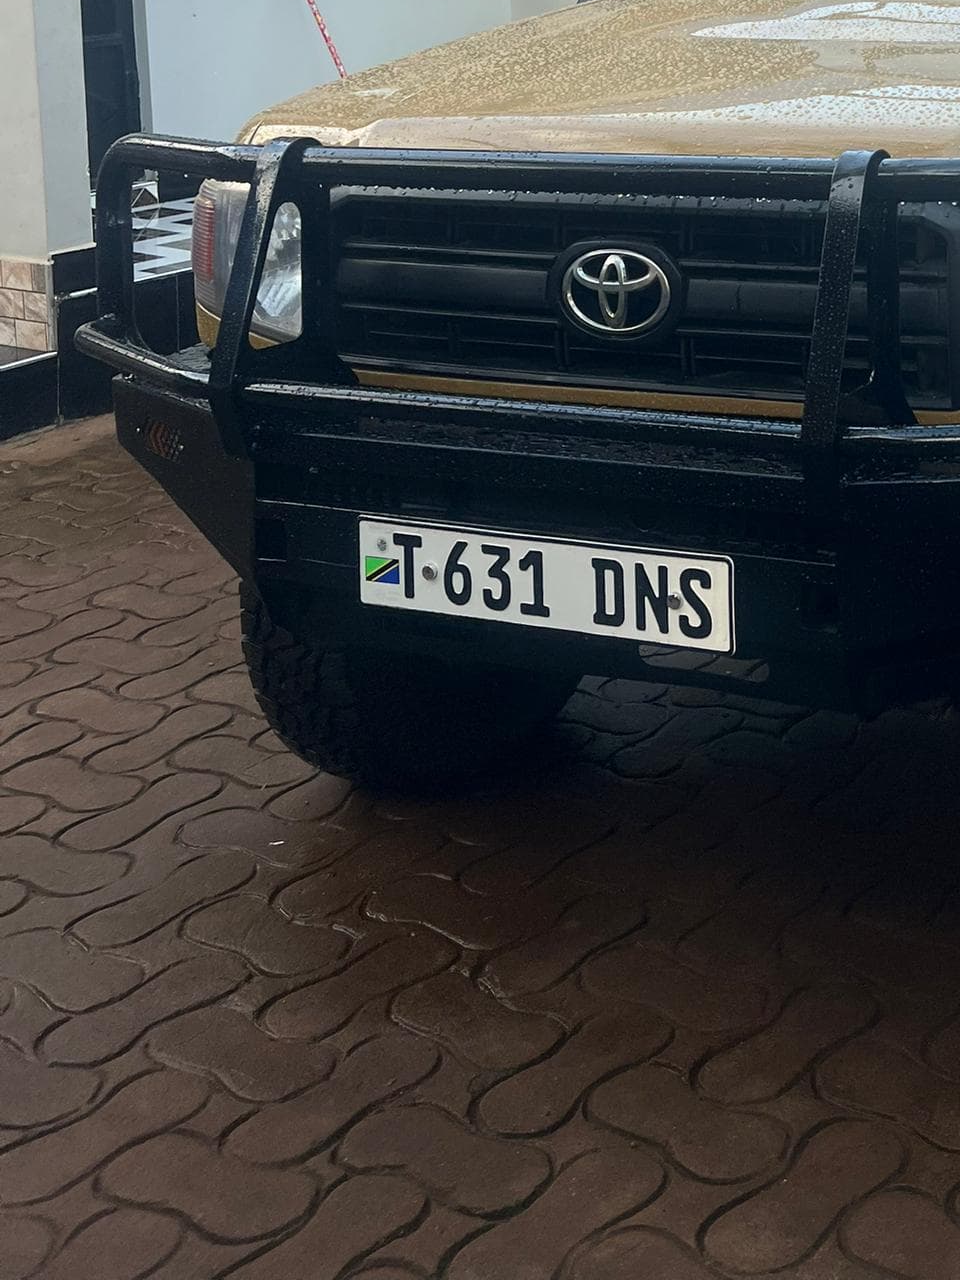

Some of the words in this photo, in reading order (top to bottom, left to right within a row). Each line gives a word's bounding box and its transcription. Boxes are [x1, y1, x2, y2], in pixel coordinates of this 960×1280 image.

[393, 533, 422, 599] T
[443, 541, 550, 618] 631
[592, 557, 713, 639] DNS
